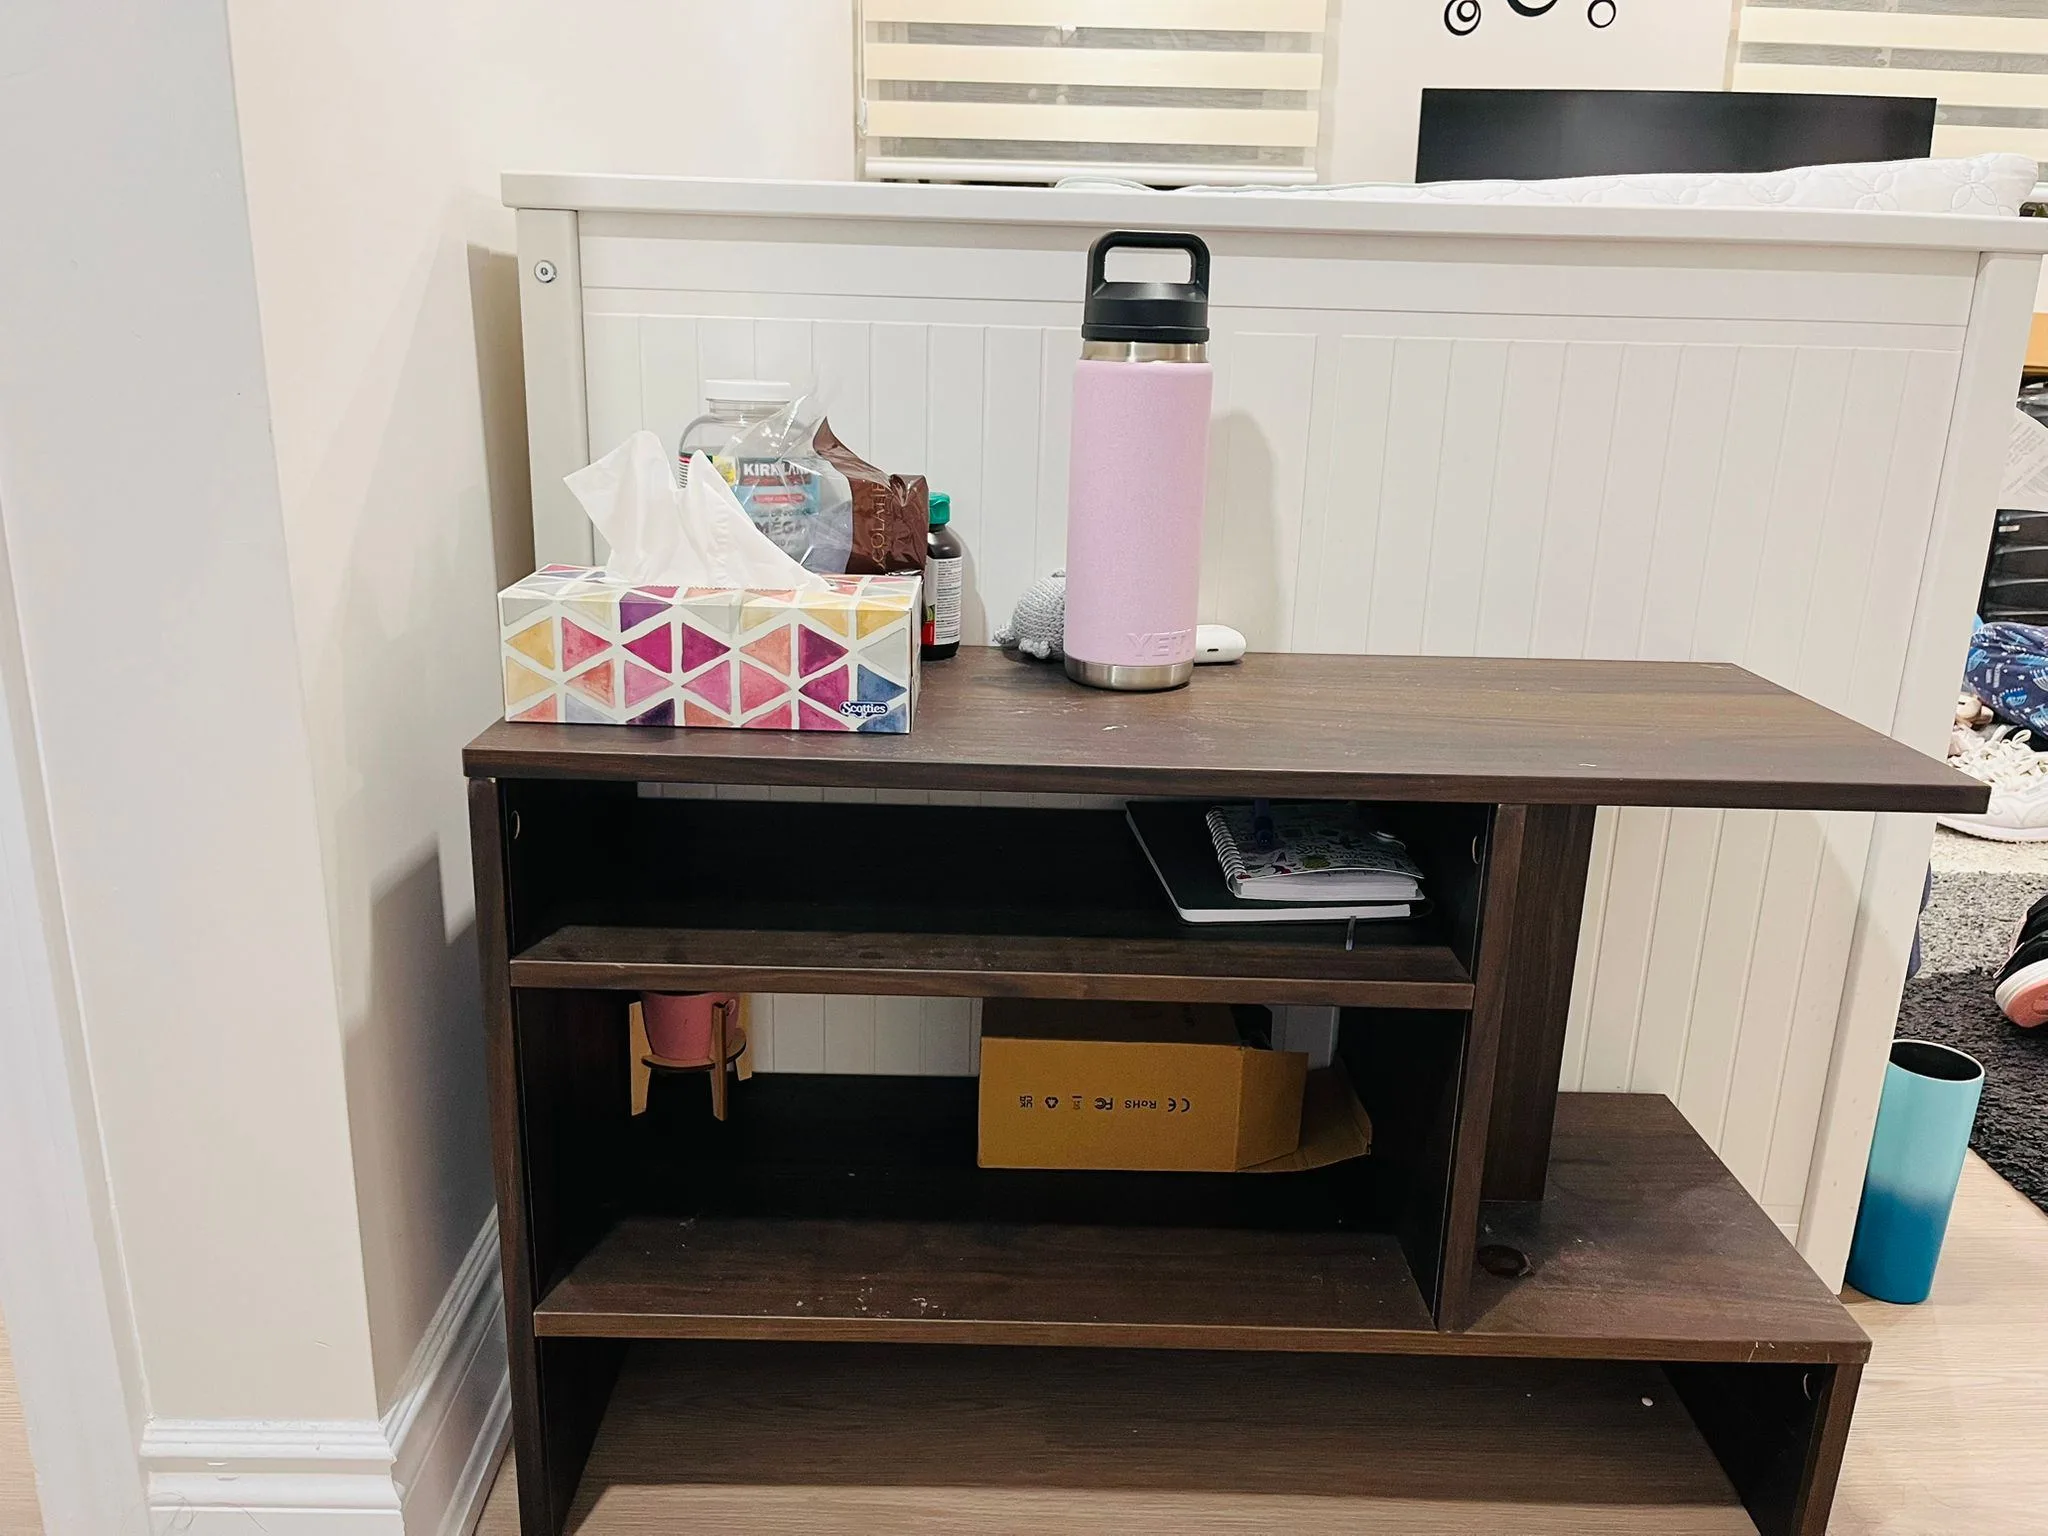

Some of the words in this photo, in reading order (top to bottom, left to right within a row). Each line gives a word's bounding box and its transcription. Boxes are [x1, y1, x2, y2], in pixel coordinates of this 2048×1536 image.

[743, 463, 810, 476] KIRKLAN
[1126, 628, 1193, 657] YETI
[842, 702, 886, 714] Scotties
